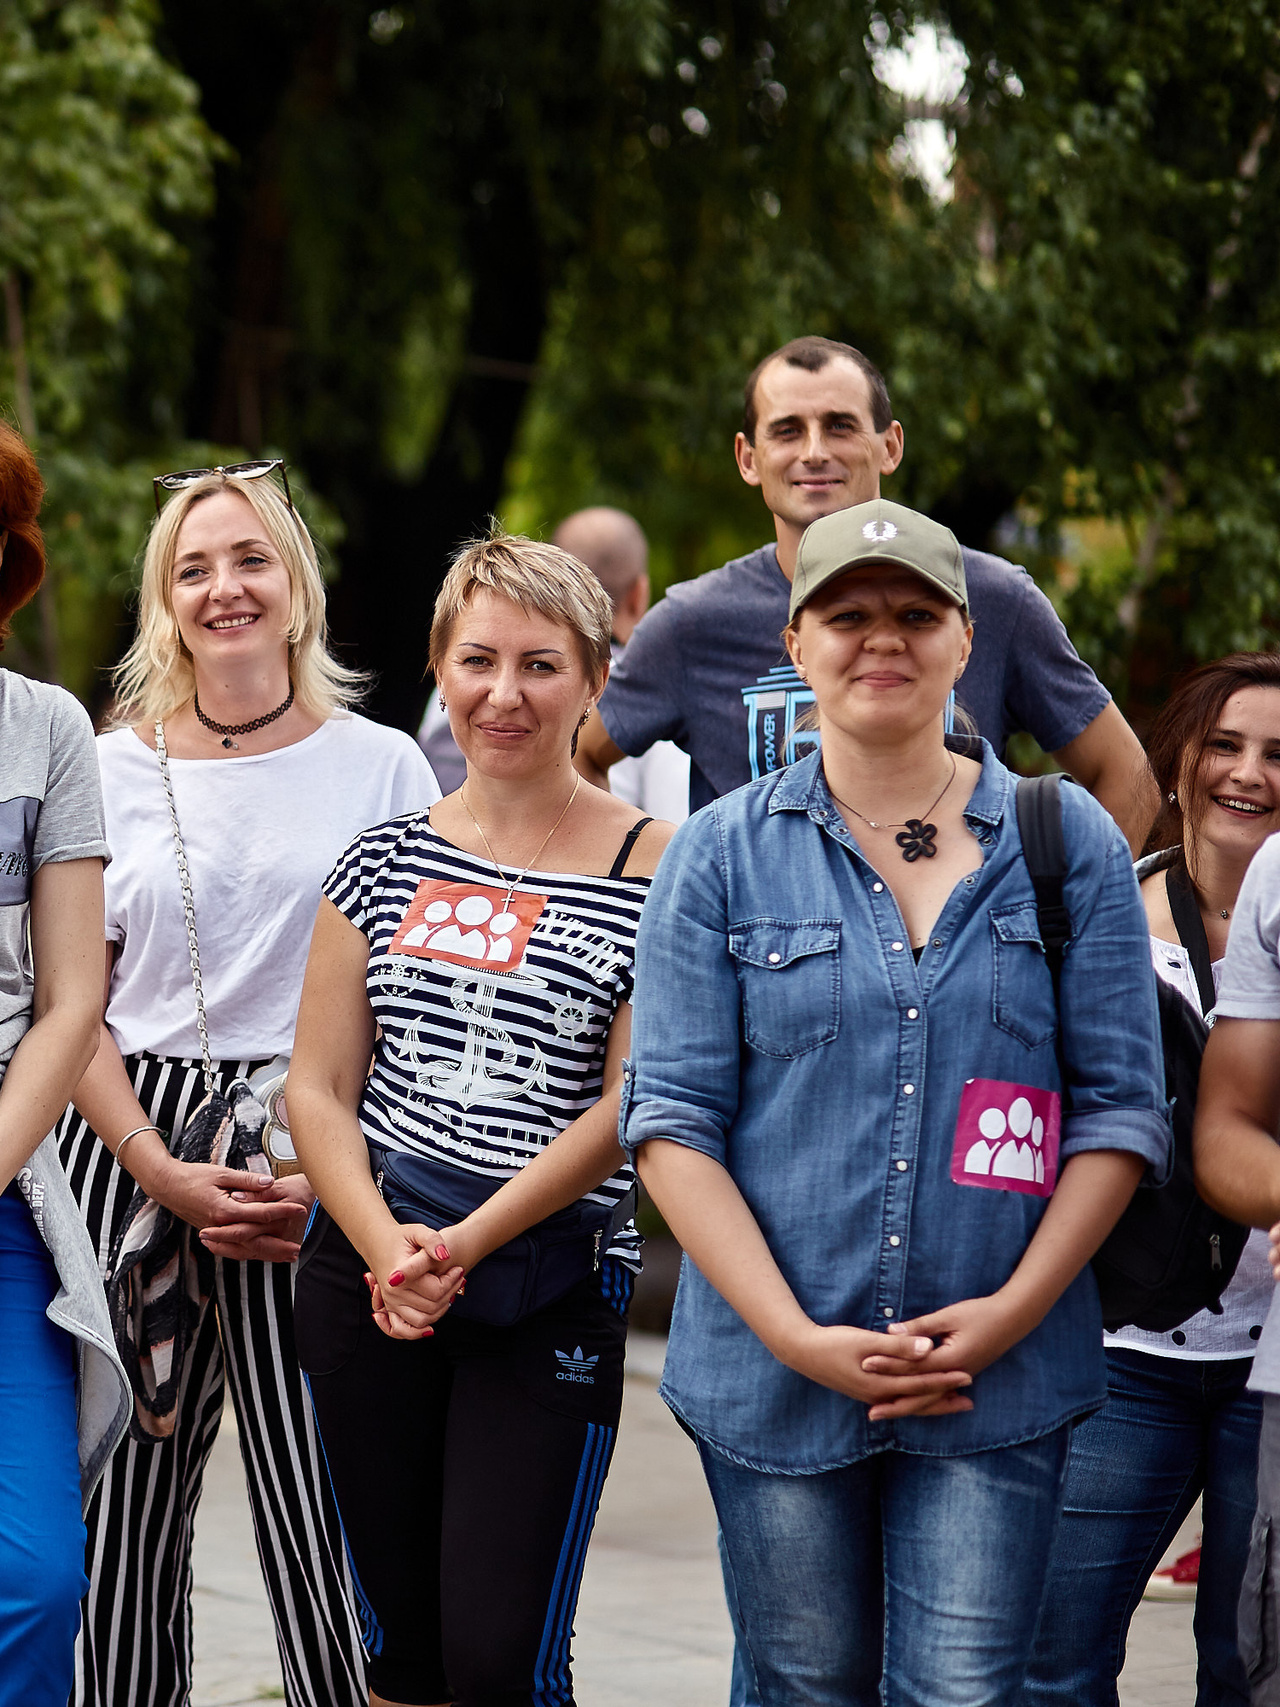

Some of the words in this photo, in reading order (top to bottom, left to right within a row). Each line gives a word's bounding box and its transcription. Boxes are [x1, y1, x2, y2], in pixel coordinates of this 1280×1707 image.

[763, 713, 777, 771] POWER
[31, 1181, 45, 1208] DEPT.
[556, 1371, 595, 1384] adidas
